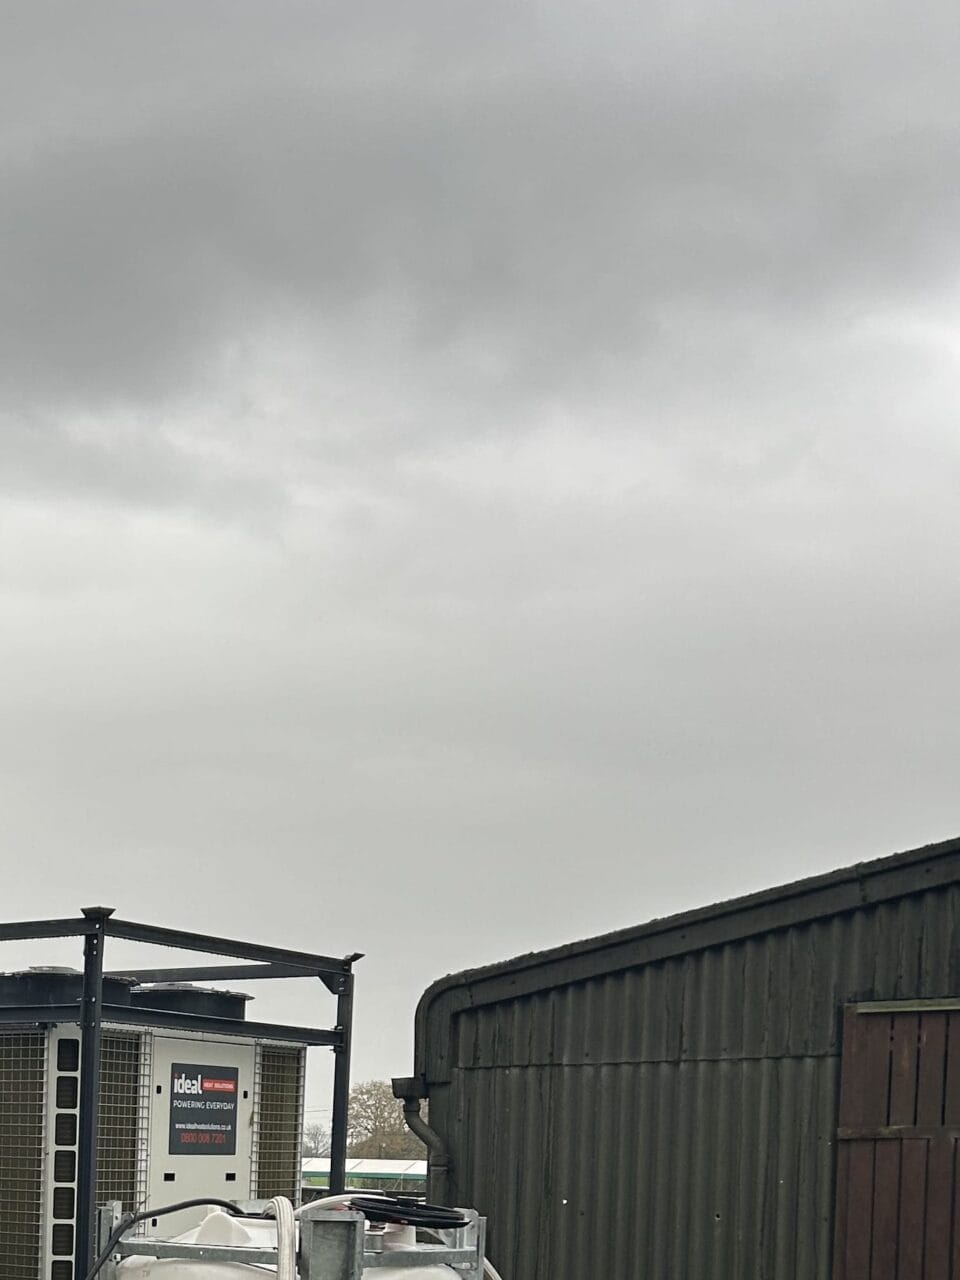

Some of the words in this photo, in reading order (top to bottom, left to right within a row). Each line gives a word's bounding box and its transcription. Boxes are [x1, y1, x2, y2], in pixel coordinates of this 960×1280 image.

[174, 1073, 202, 1094] ideal
[173, 1100, 205, 1109] POWERING
[206, 1101, 235, 1110] EVERYDAY
